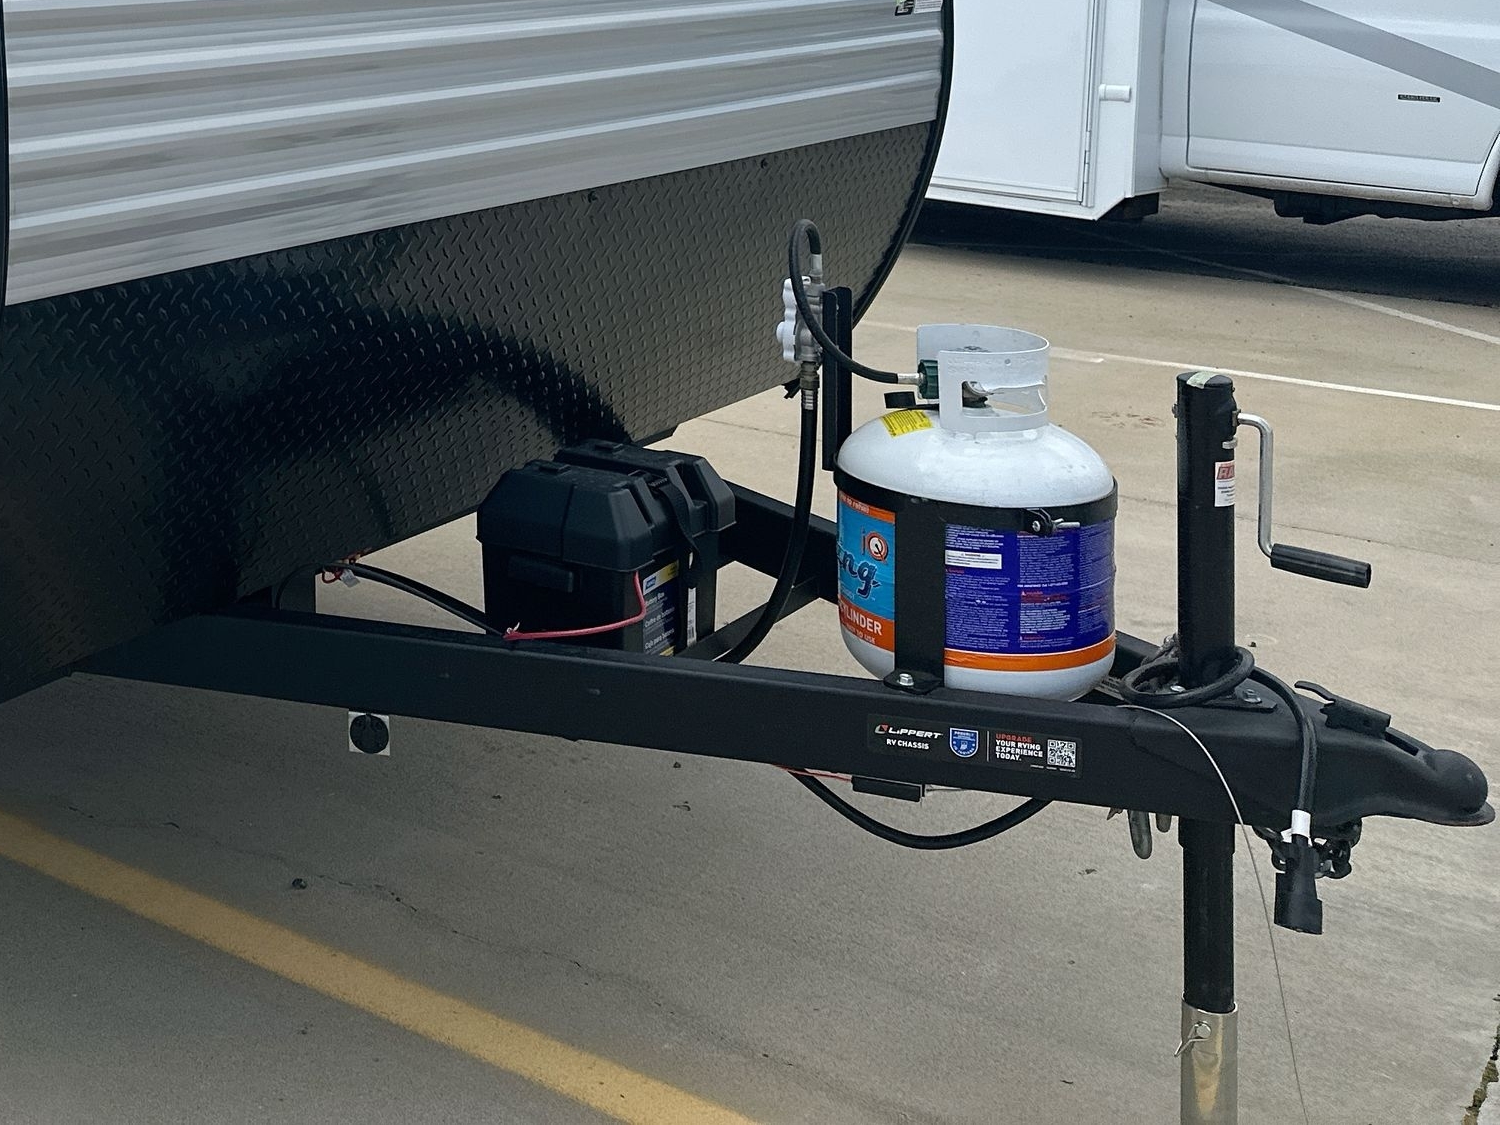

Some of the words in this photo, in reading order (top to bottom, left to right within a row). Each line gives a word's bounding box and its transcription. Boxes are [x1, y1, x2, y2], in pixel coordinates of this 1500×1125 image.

[886, 738, 897, 746] RV
[897, 740, 930, 750] CHASSIS
[995, 733, 1032, 743] UPGRADE
[995, 739, 1016, 748] YOUR
[1017, 742, 1041, 751] RVING
[995, 745, 1044, 758] EXPERIENCE
[995, 752, 1022, 761] TODAY.
